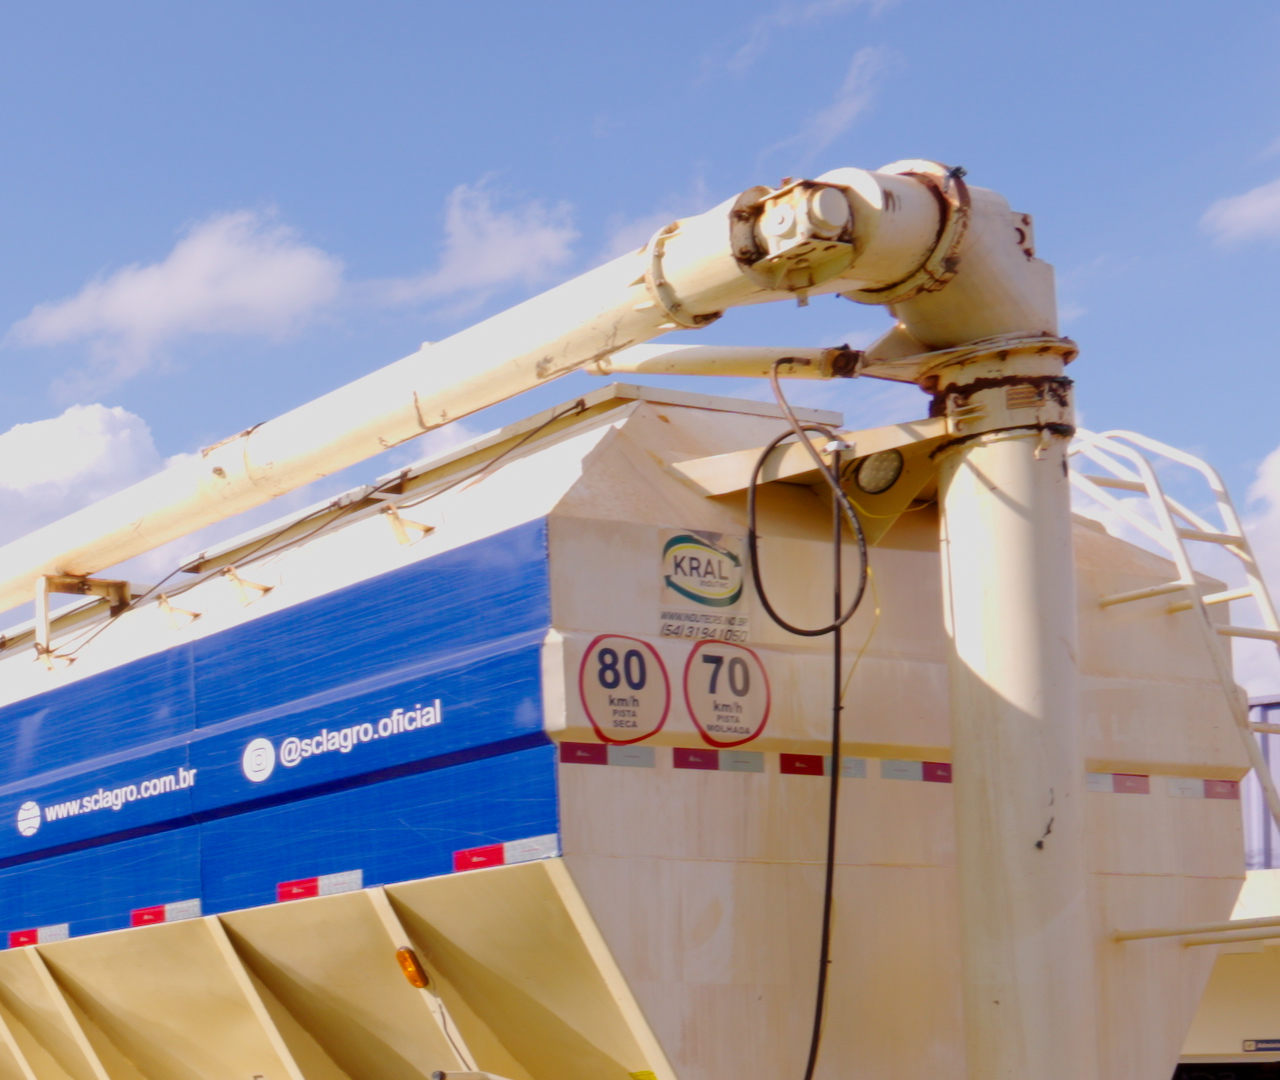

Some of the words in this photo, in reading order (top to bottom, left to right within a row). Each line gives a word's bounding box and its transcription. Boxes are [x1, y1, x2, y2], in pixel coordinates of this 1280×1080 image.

[673, 555, 728, 580] KRAL
[597, 647, 646, 691] 80
[702, 654, 750, 697] 70
[608, 695, 639, 708] km/h
[713, 701, 743, 714] km/h
[612, 709, 637, 718] PISTA
[716, 715, 740, 724] PISTA
[612, 719, 638, 728] SECA
[706, 724, 751, 735] MOLHADA
[280, 699, 442, 768] @sclagro.oficial
[44, 767, 198, 823] www.sclagro.com.br
